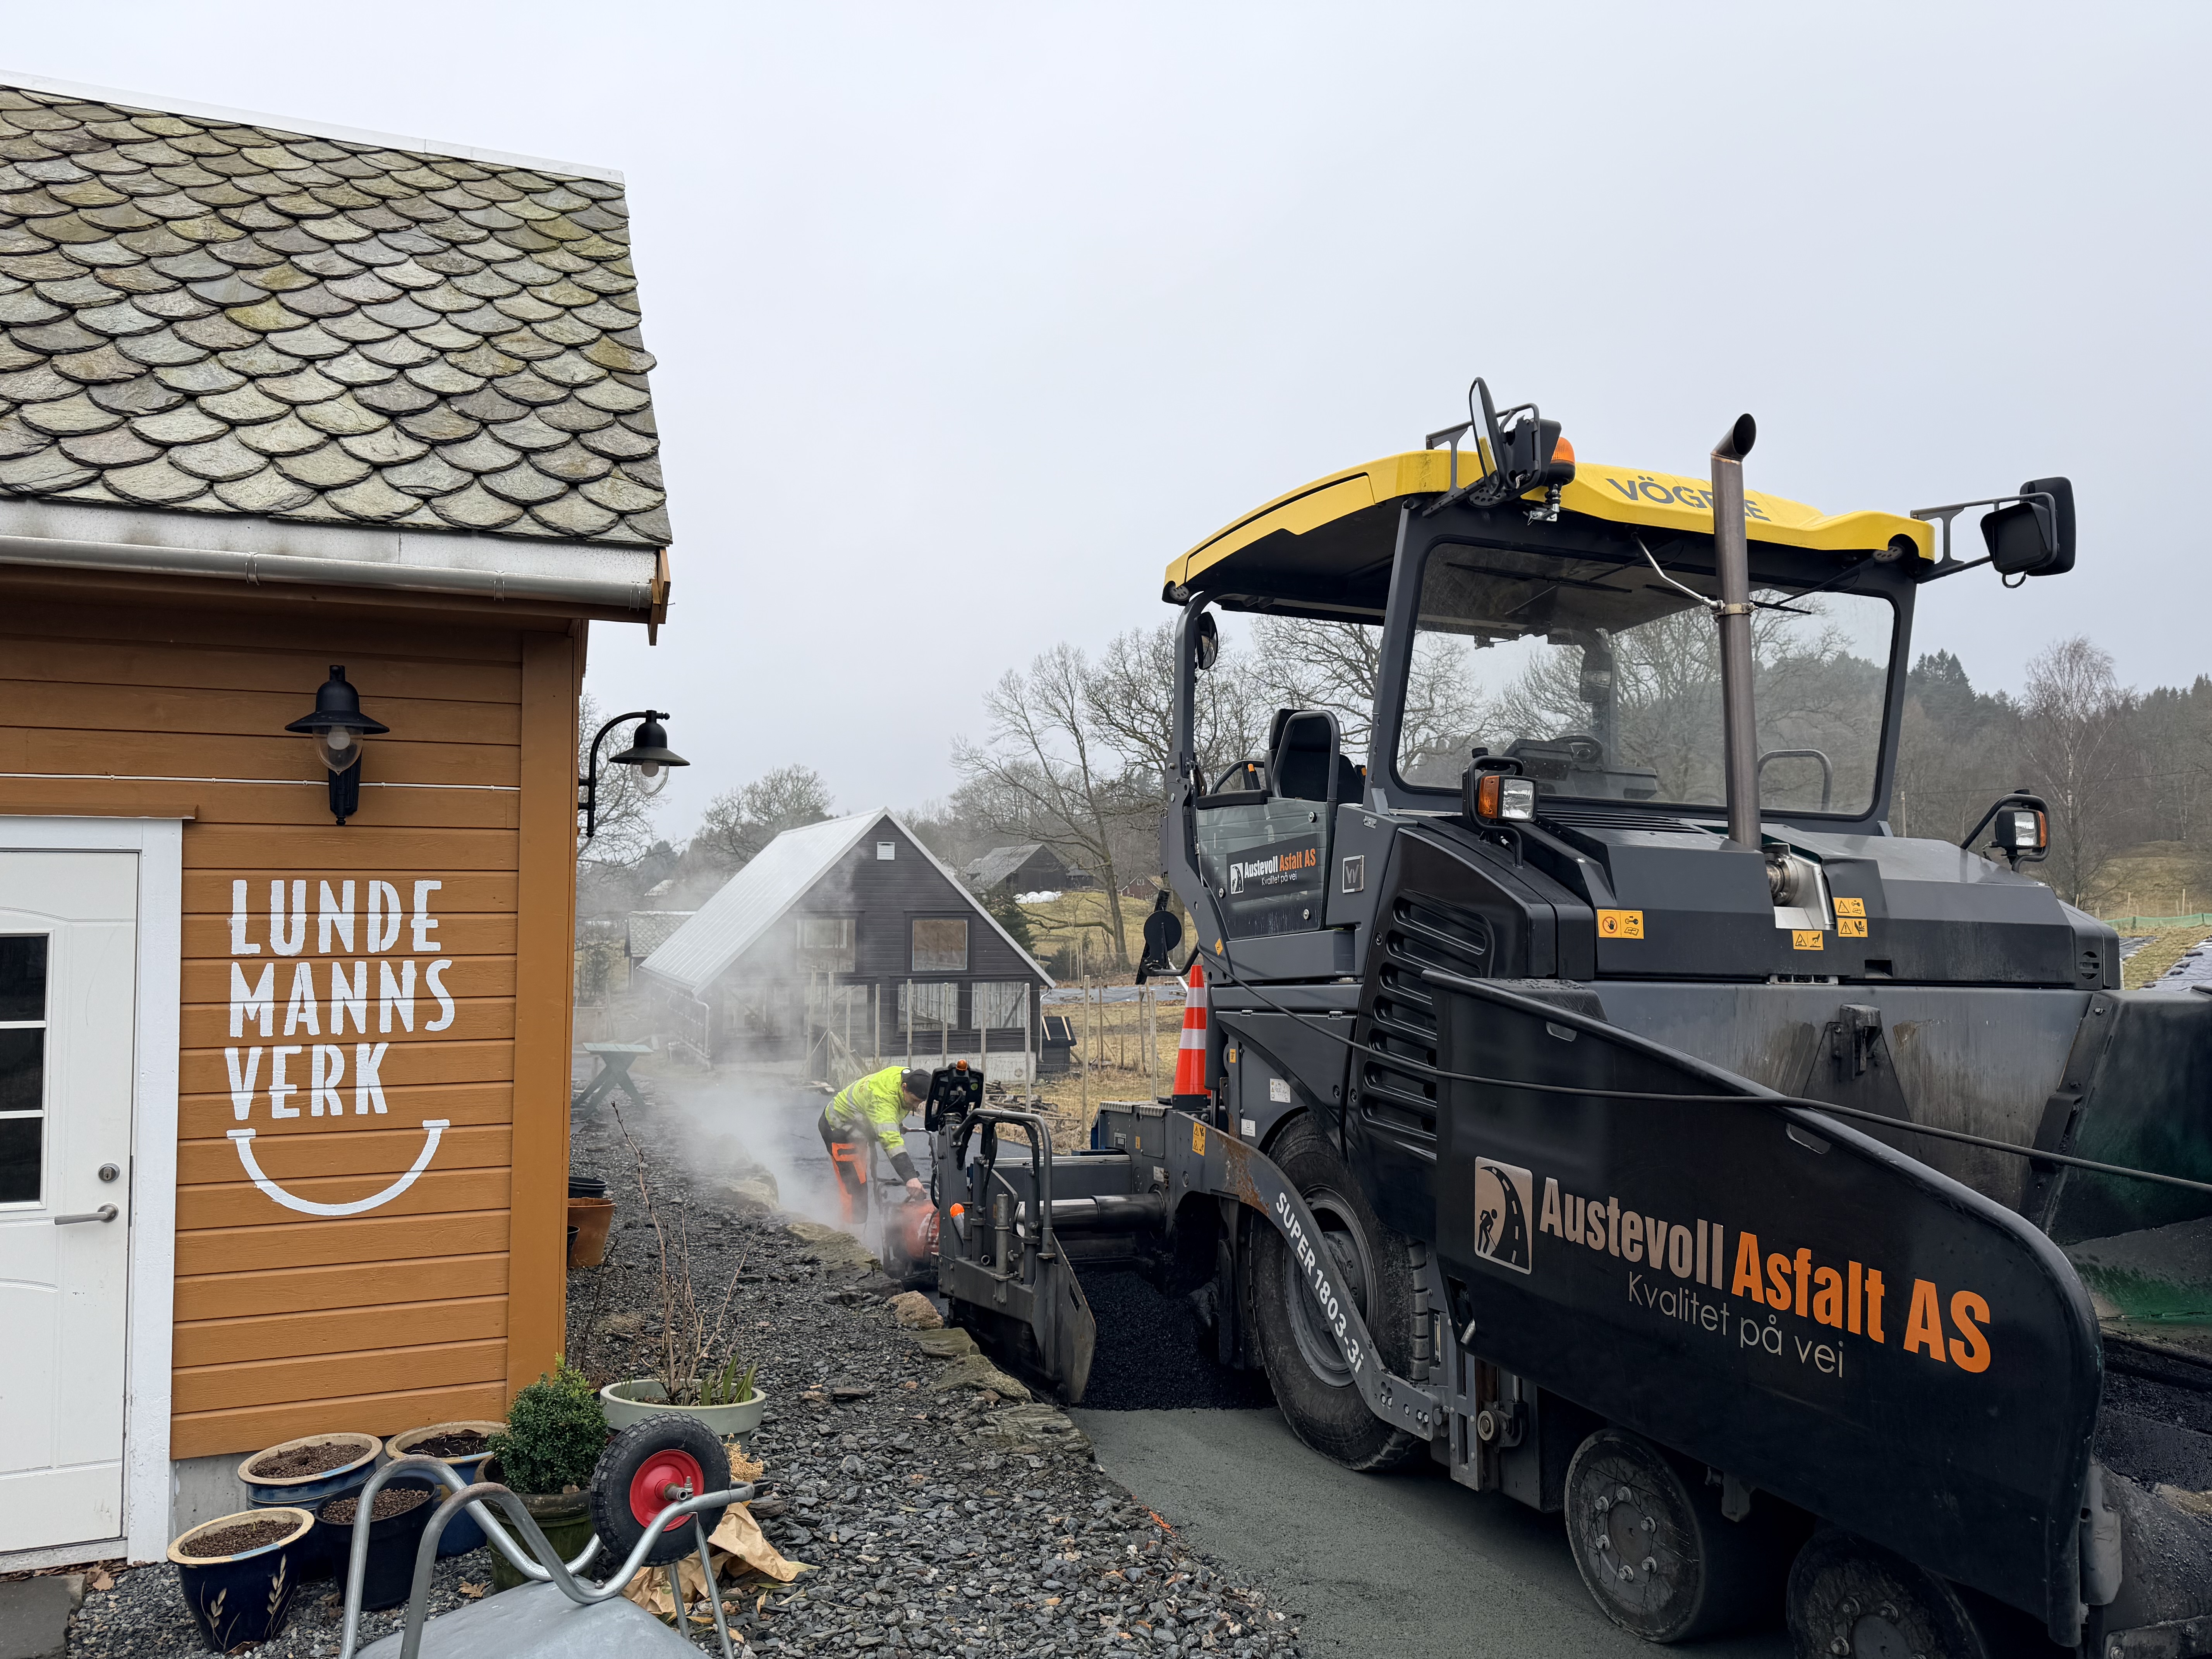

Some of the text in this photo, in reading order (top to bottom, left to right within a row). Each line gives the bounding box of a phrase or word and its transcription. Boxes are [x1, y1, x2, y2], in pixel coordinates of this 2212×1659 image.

[1605, 475, 1772, 522] VÖGEE
[1244, 848, 1316, 878] Austevoll Asfalt AS
[1261, 874, 1279, 886] Kvalitet
[1281, 872, 1288, 884] på
[230, 879, 442, 956] LUNDE
[230, 959, 455, 1037] MANNS
[225, 1042, 389, 1120] VERK
[1276, 1192, 1364, 1374] SUPER 1803-3i
[1539, 1177, 1991, 1373] Austevoll Asfalt AS
[1629, 1271, 1844, 1378] Kvalitet på vei
